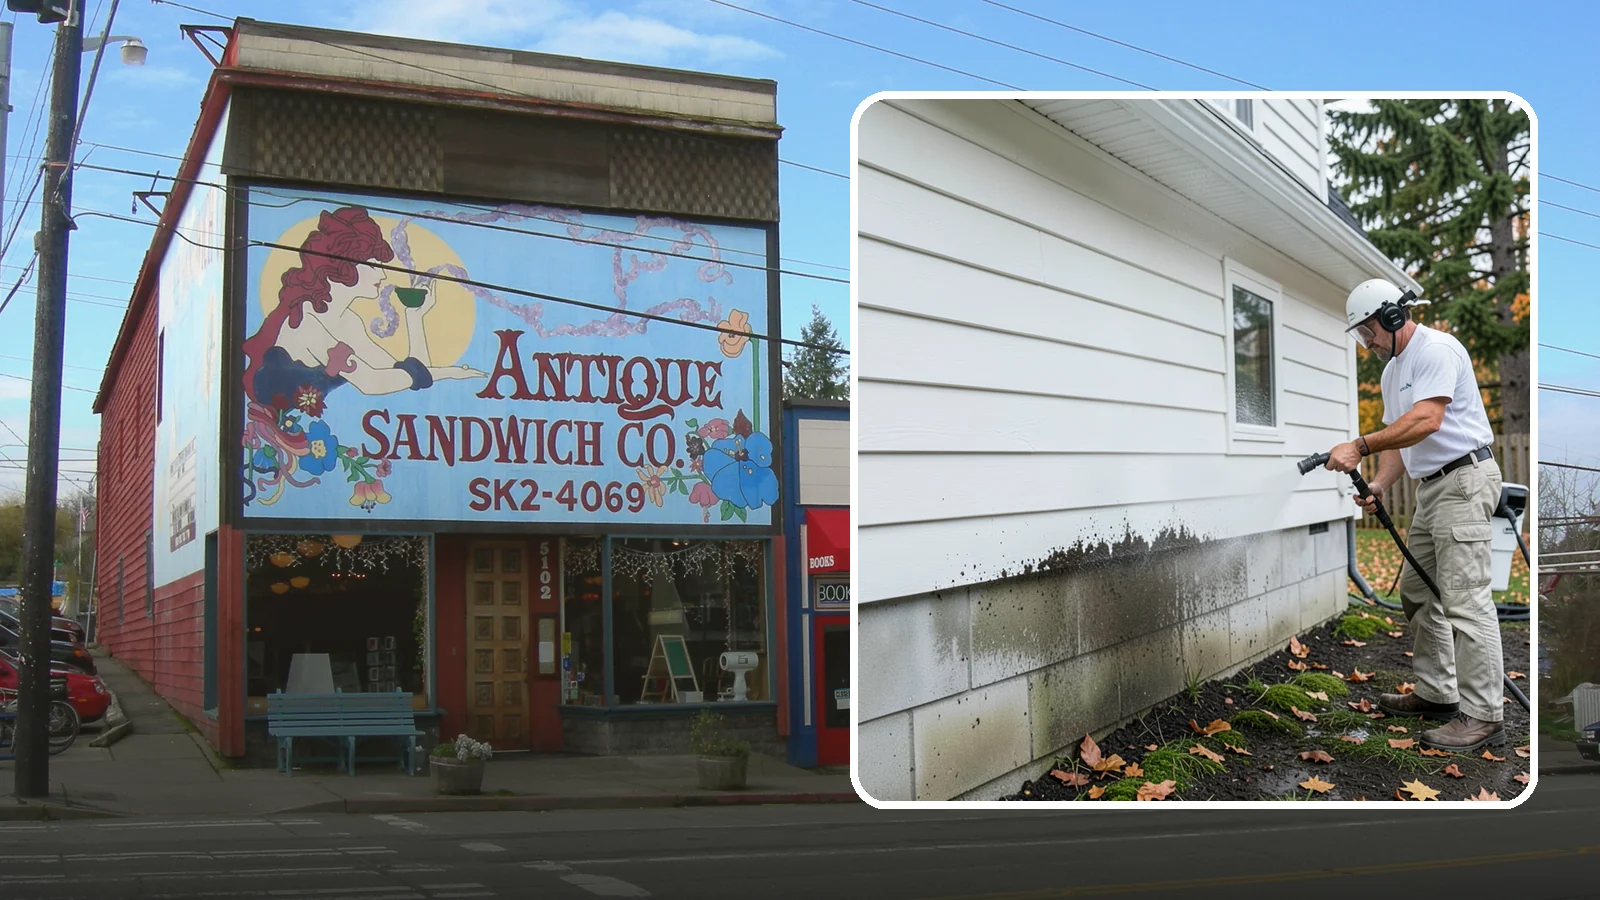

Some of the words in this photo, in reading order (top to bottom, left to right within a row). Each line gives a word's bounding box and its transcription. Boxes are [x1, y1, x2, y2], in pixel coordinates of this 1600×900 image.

[476, 329, 723, 421] ANTIQUE
[361, 409, 604, 467] SANDWICH
[617, 422, 685, 468] CO.
[468, 477, 645, 513] SK2-4069
[540, 541, 551, 600] 5102
[809, 555, 835, 569] BOOKS
